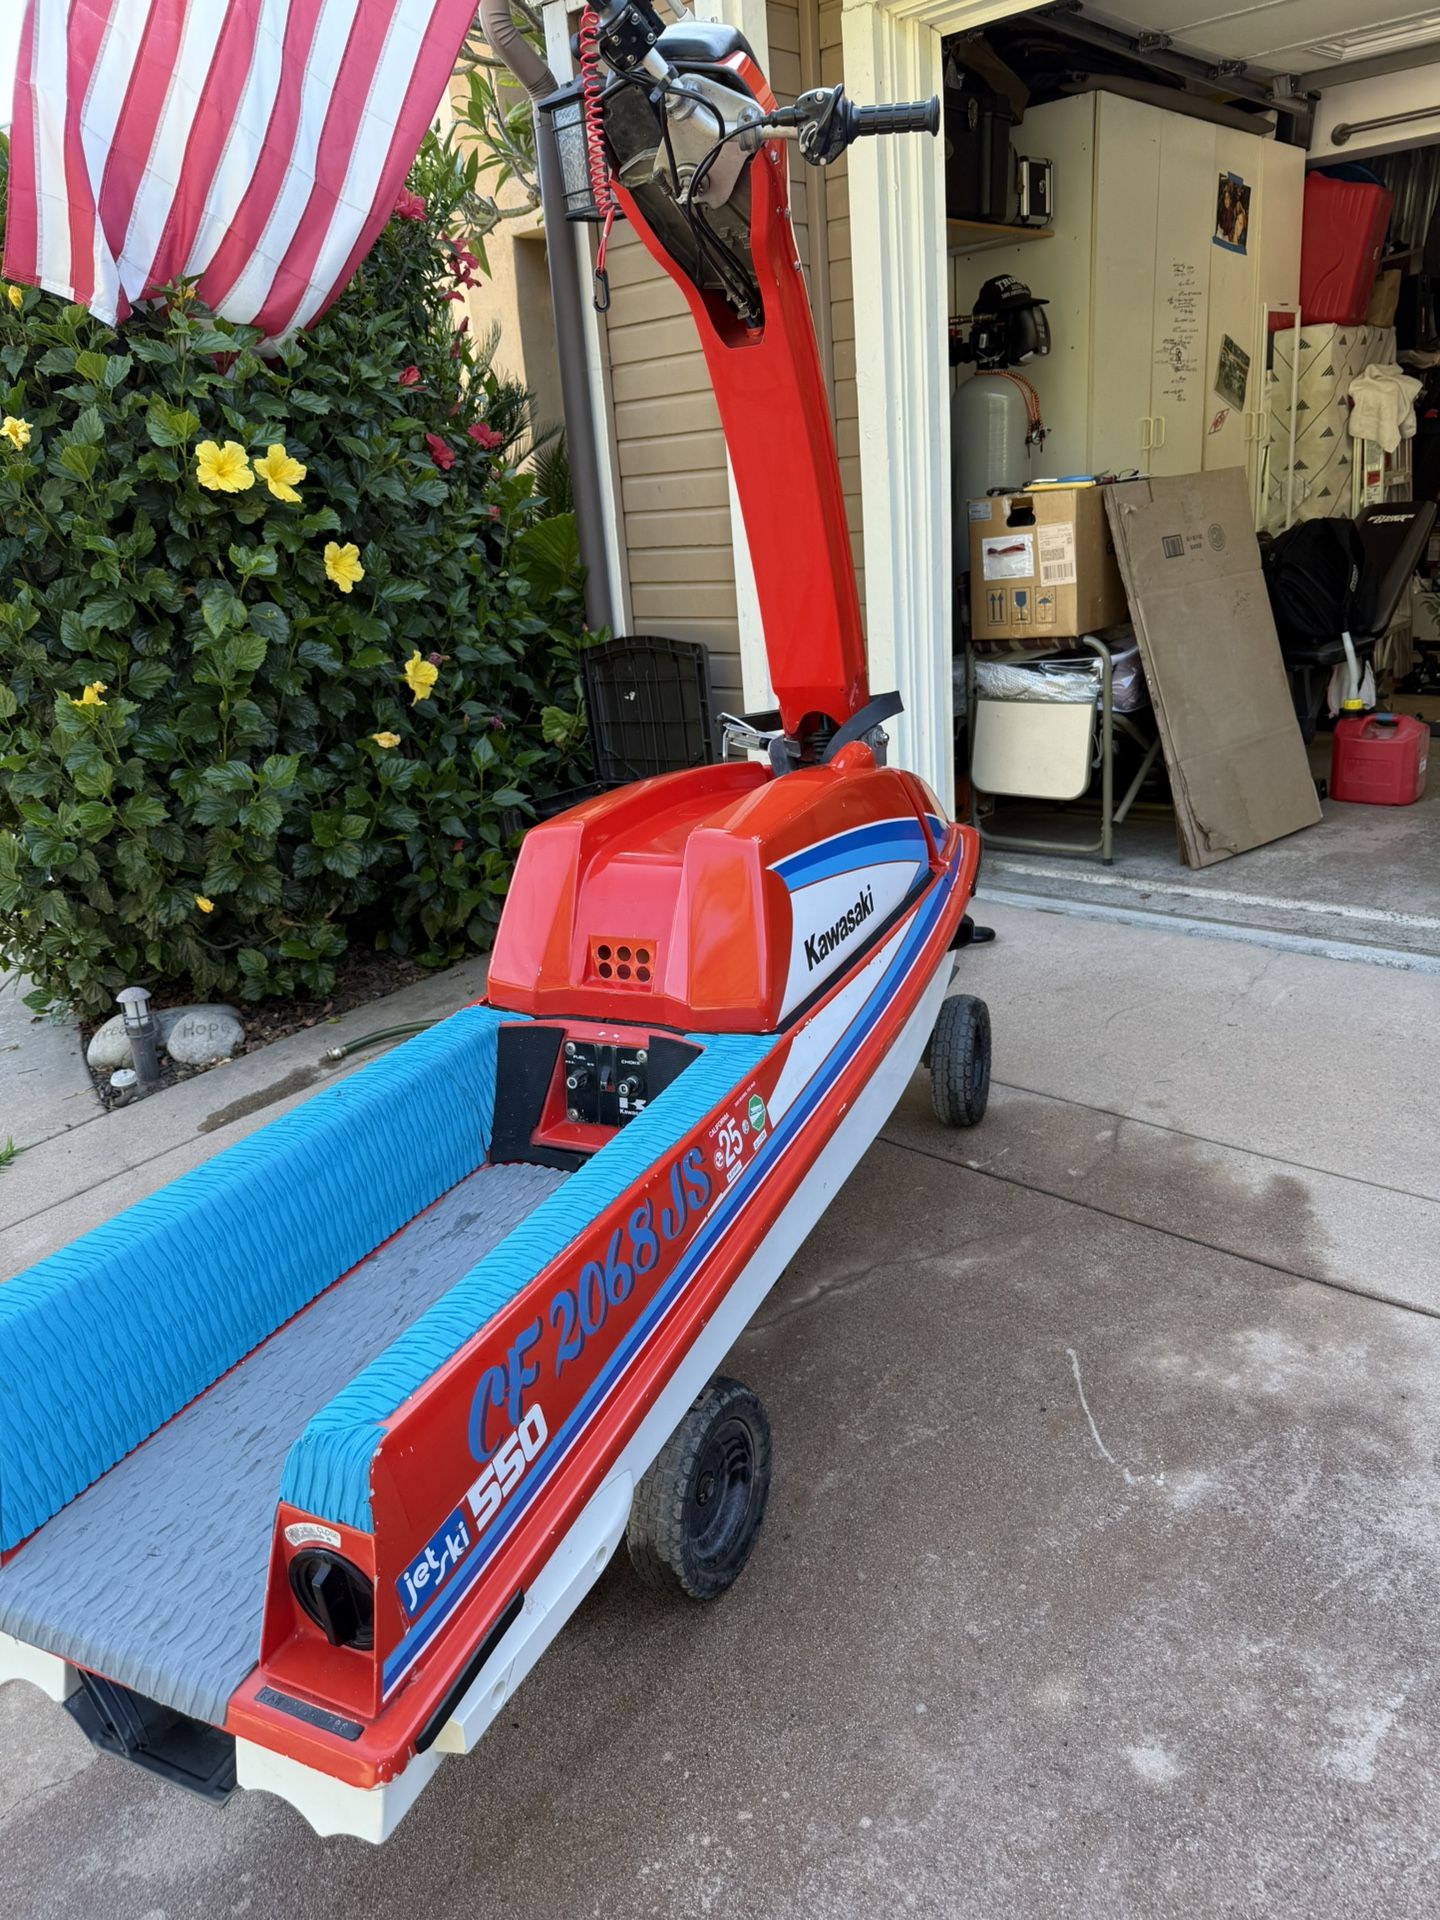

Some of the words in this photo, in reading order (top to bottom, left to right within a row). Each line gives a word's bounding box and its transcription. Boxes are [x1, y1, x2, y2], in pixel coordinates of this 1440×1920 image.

[804, 884, 874, 971] Kawasaki
[182, 1021, 232, 1040] Hope
[708, 1112, 730, 1138] CALIFORNIA
[719, 1117, 744, 1168] 25
[468, 1316, 543, 1464] CF
[549, 1198, 661, 1380] 2068
[467, 1403, 548, 1532] 550
